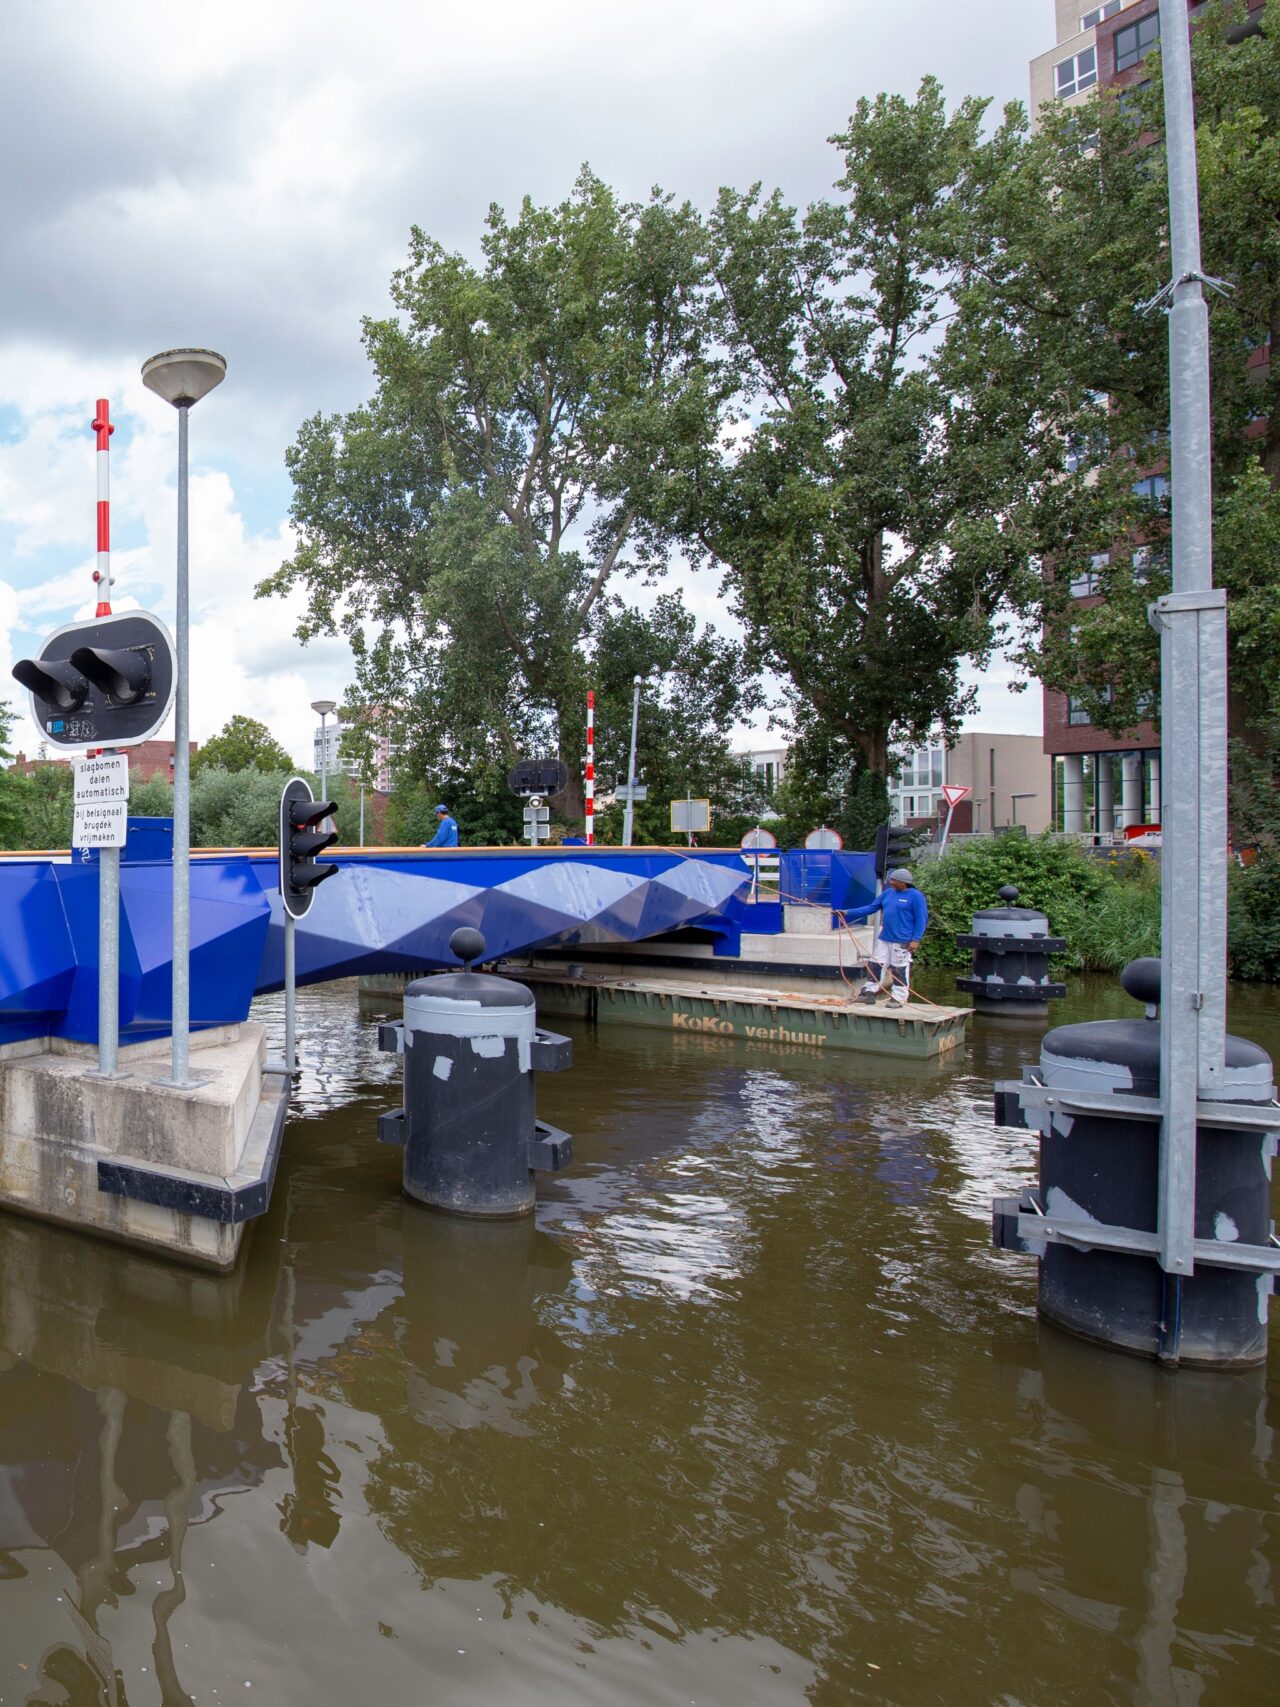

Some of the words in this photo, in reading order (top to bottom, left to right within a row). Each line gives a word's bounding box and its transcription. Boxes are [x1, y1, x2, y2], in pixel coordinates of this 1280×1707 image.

[80, 761, 120, 773] slagbomen
[89, 775, 110, 784] dalen
[76, 786, 125, 798] automatisch
[76, 810, 85, 820] bij
[86, 807, 122, 819] belsignaal
[84, 820, 112, 832] brugdek
[80, 833, 115, 843] vrijmaken
[745, 1025, 827, 1046] verhuur
